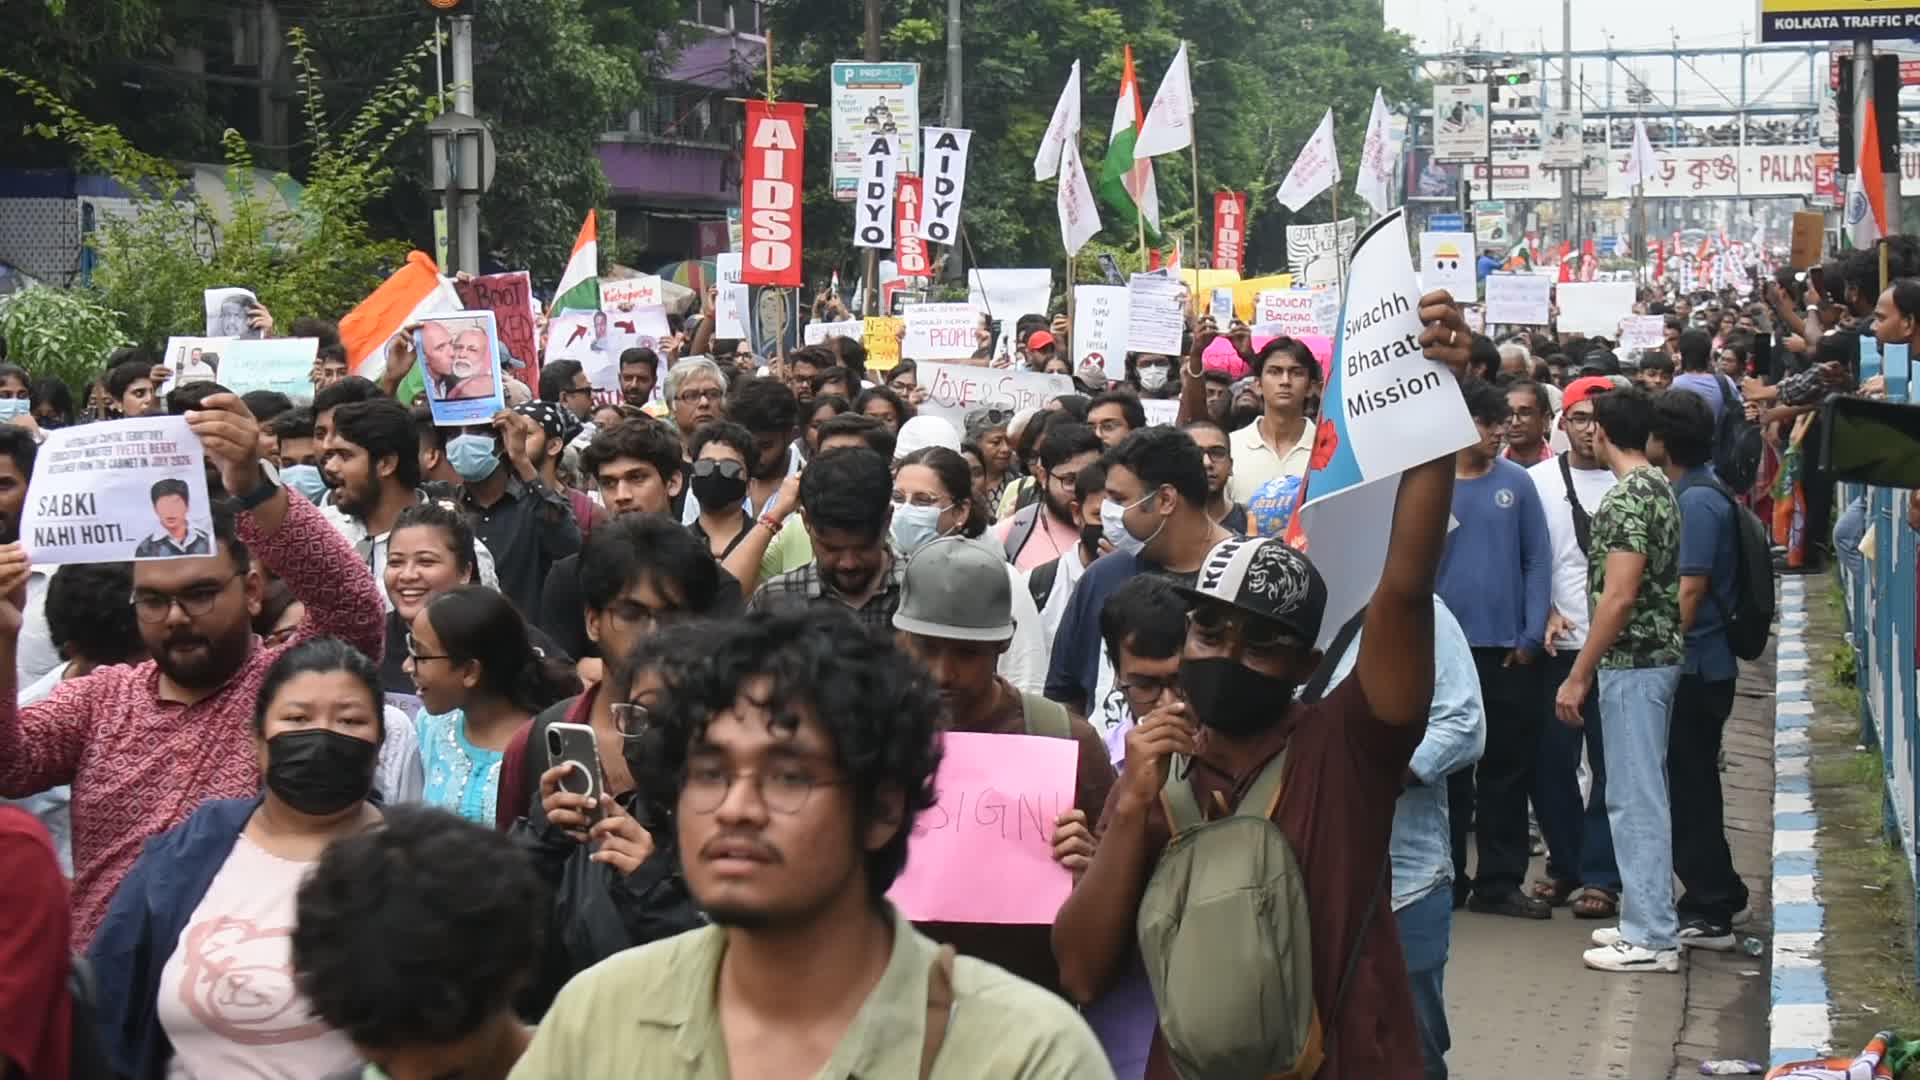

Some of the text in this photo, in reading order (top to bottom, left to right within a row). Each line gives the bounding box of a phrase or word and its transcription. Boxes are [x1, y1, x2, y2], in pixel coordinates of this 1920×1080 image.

[1774, 16, 1839, 30] KOLKATA
[1843, 14, 1901, 28] TRAFFIC
[750, 118, 797, 271] AIDSO
[861, 137, 891, 244] AIDYO
[927, 132, 961, 240] AIDYO
[899, 184, 926, 271] AIDSO
[929, 328, 977, 347] PEOPLE
[1347, 333, 1421, 377] Bharat
[1347, 370, 1440, 419] Mission
[37, 492, 97, 517] SABKI
[34, 525, 77, 548] NAHI
